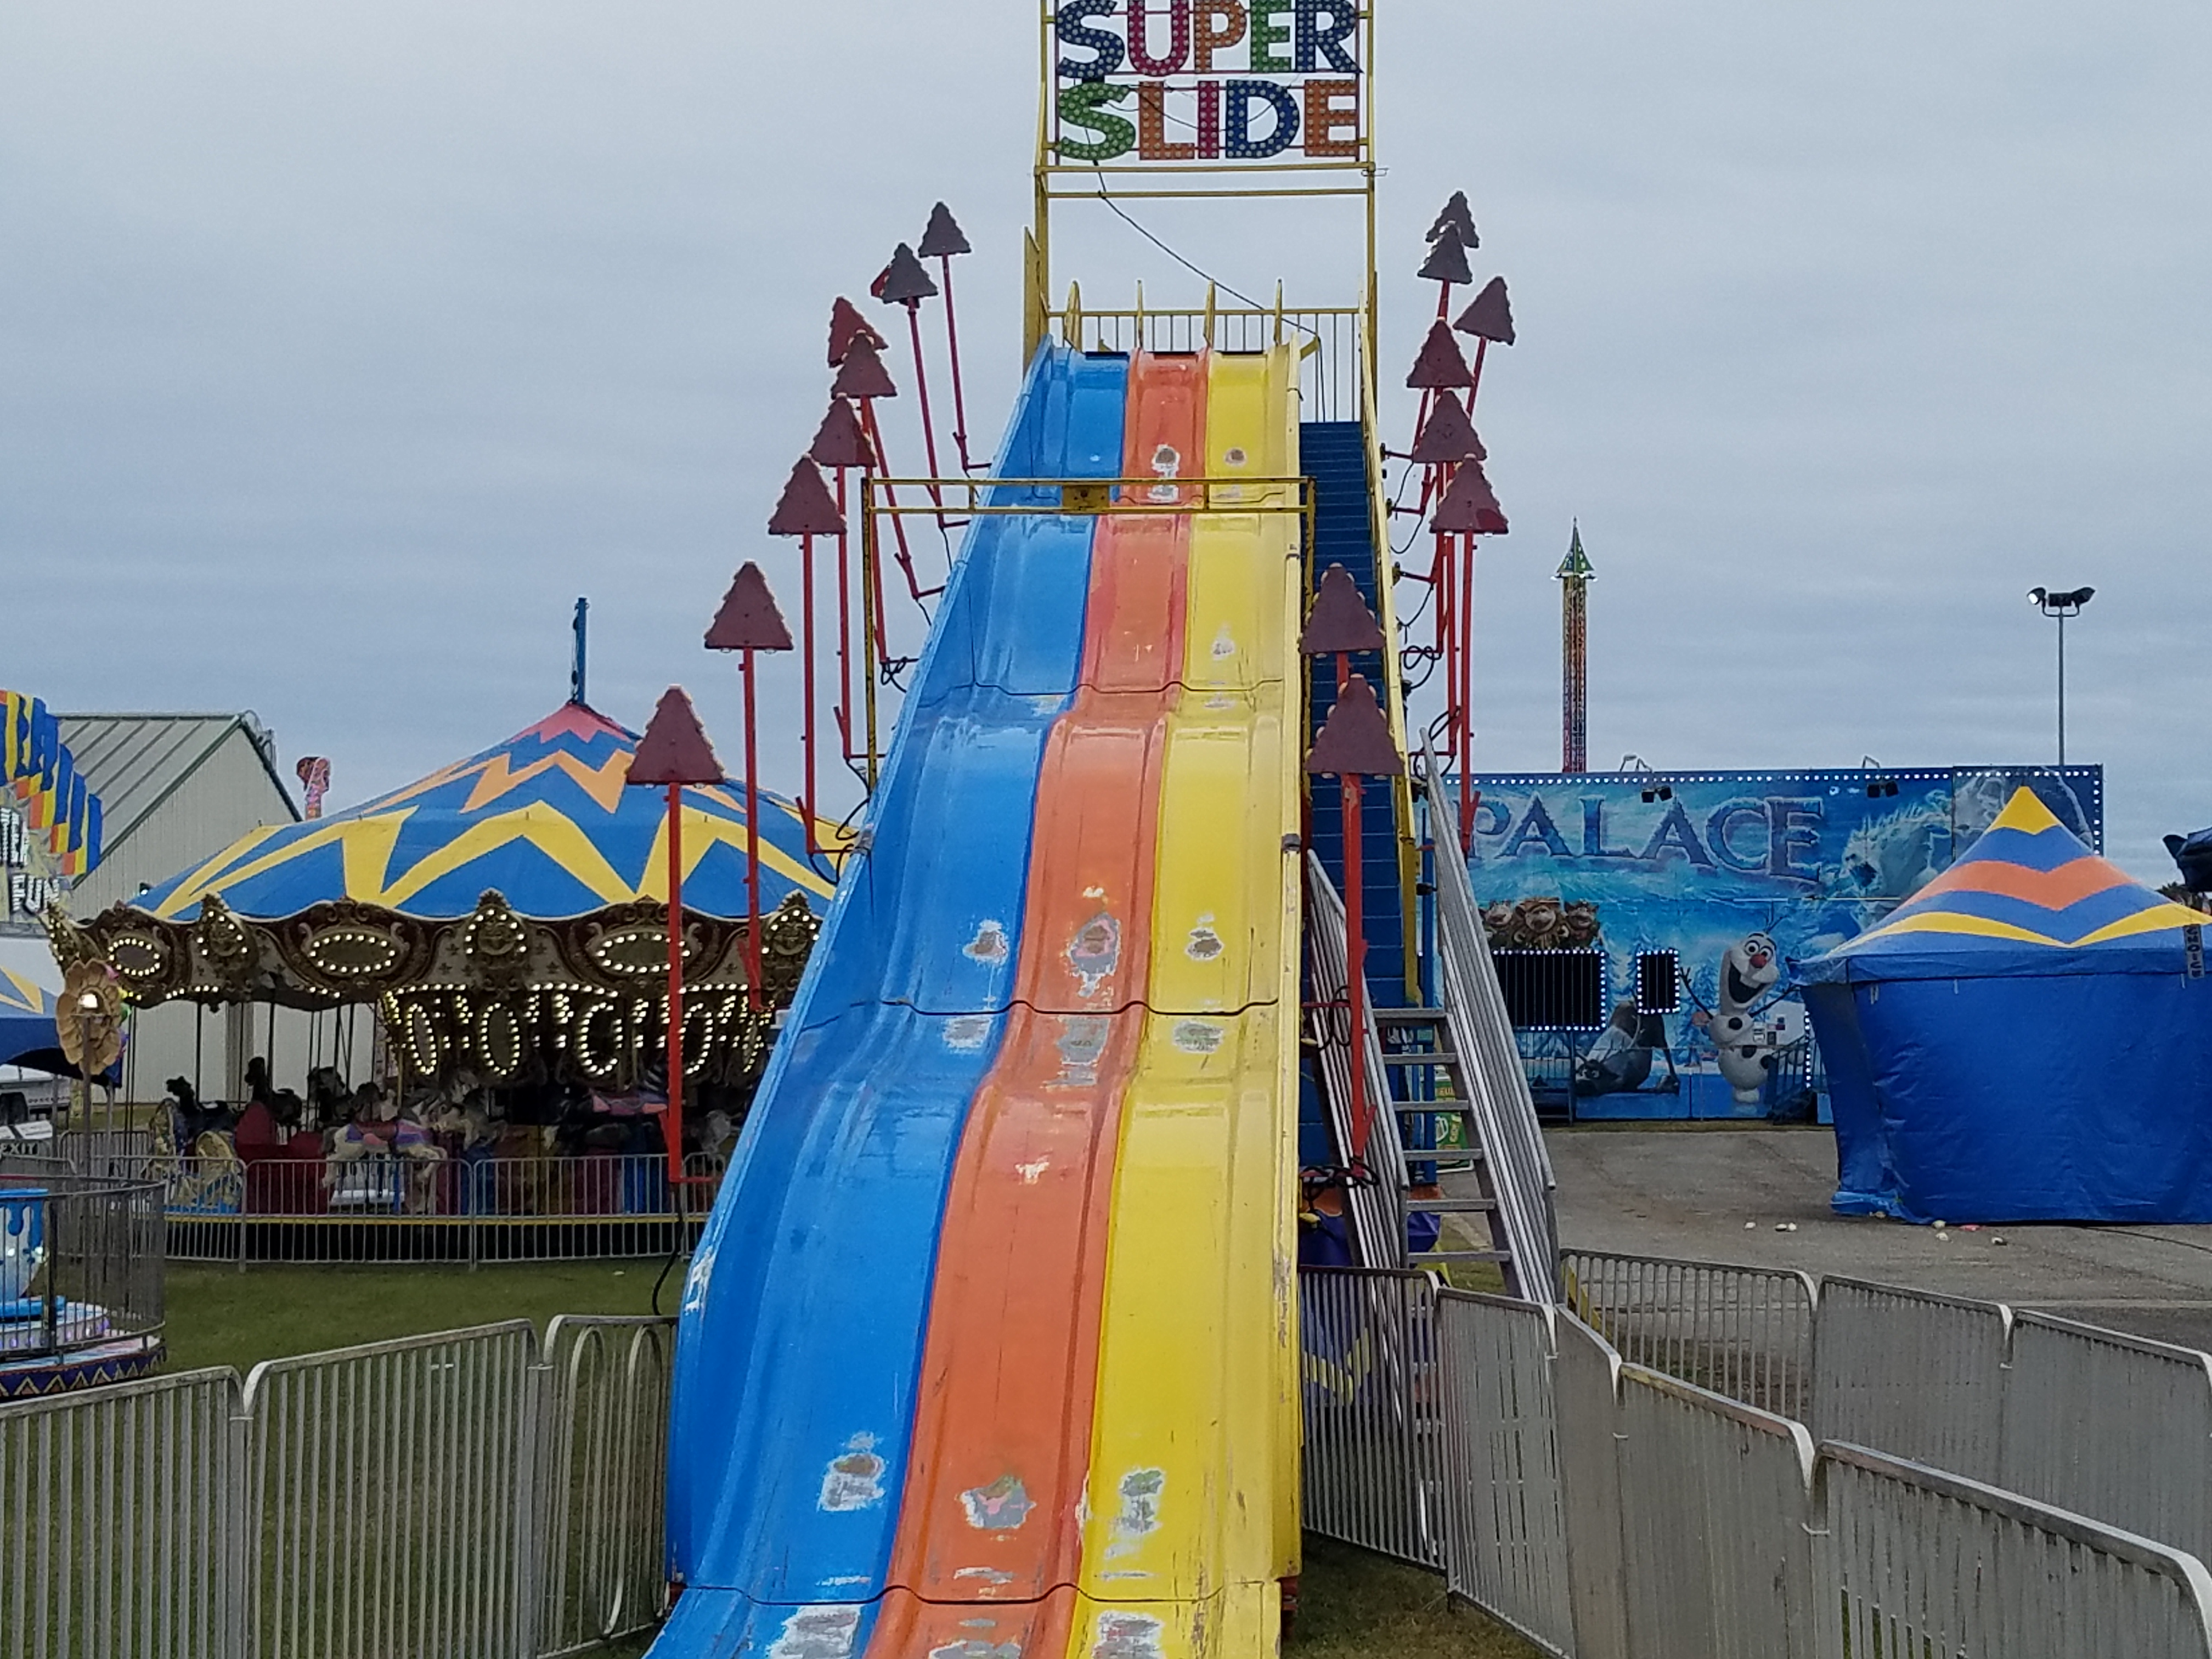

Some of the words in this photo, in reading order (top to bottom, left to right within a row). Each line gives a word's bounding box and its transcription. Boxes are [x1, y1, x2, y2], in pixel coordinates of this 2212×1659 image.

[1056, 0, 1364, 76] SUPER
[1053, 79, 1358, 161] SLIDE
[1453, 792, 1822, 882] PALACE
[12, 874, 59, 913] FUN
[0, 1142, 36, 1154] EXIT
